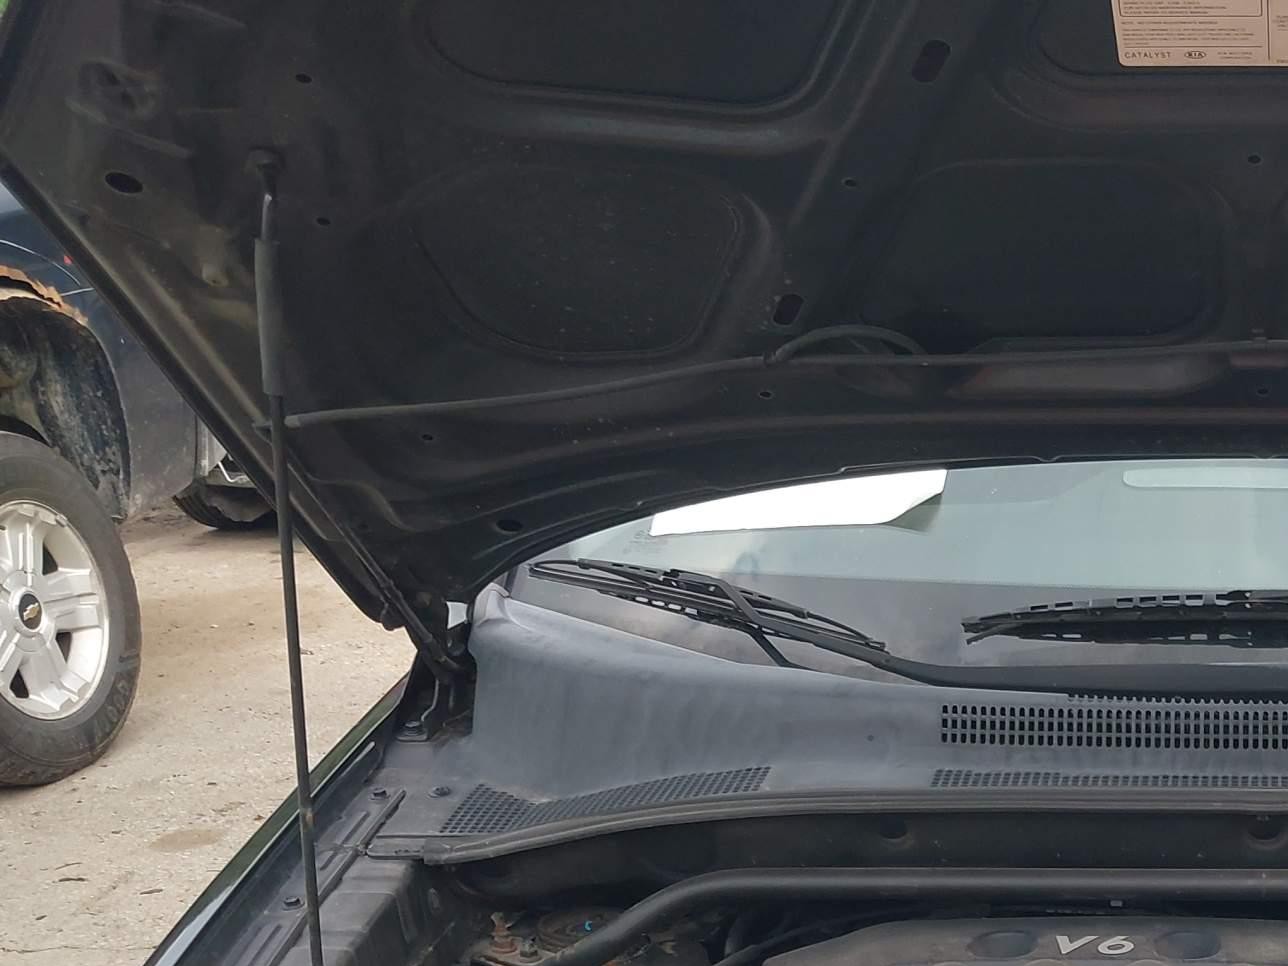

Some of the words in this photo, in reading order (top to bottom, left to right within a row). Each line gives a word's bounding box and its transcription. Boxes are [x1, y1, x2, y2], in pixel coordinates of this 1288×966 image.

[1124, 51, 1171, 59] CATALYST
[1187, 51, 1204, 59] KIA
[1056, 935, 1134, 954] V6
